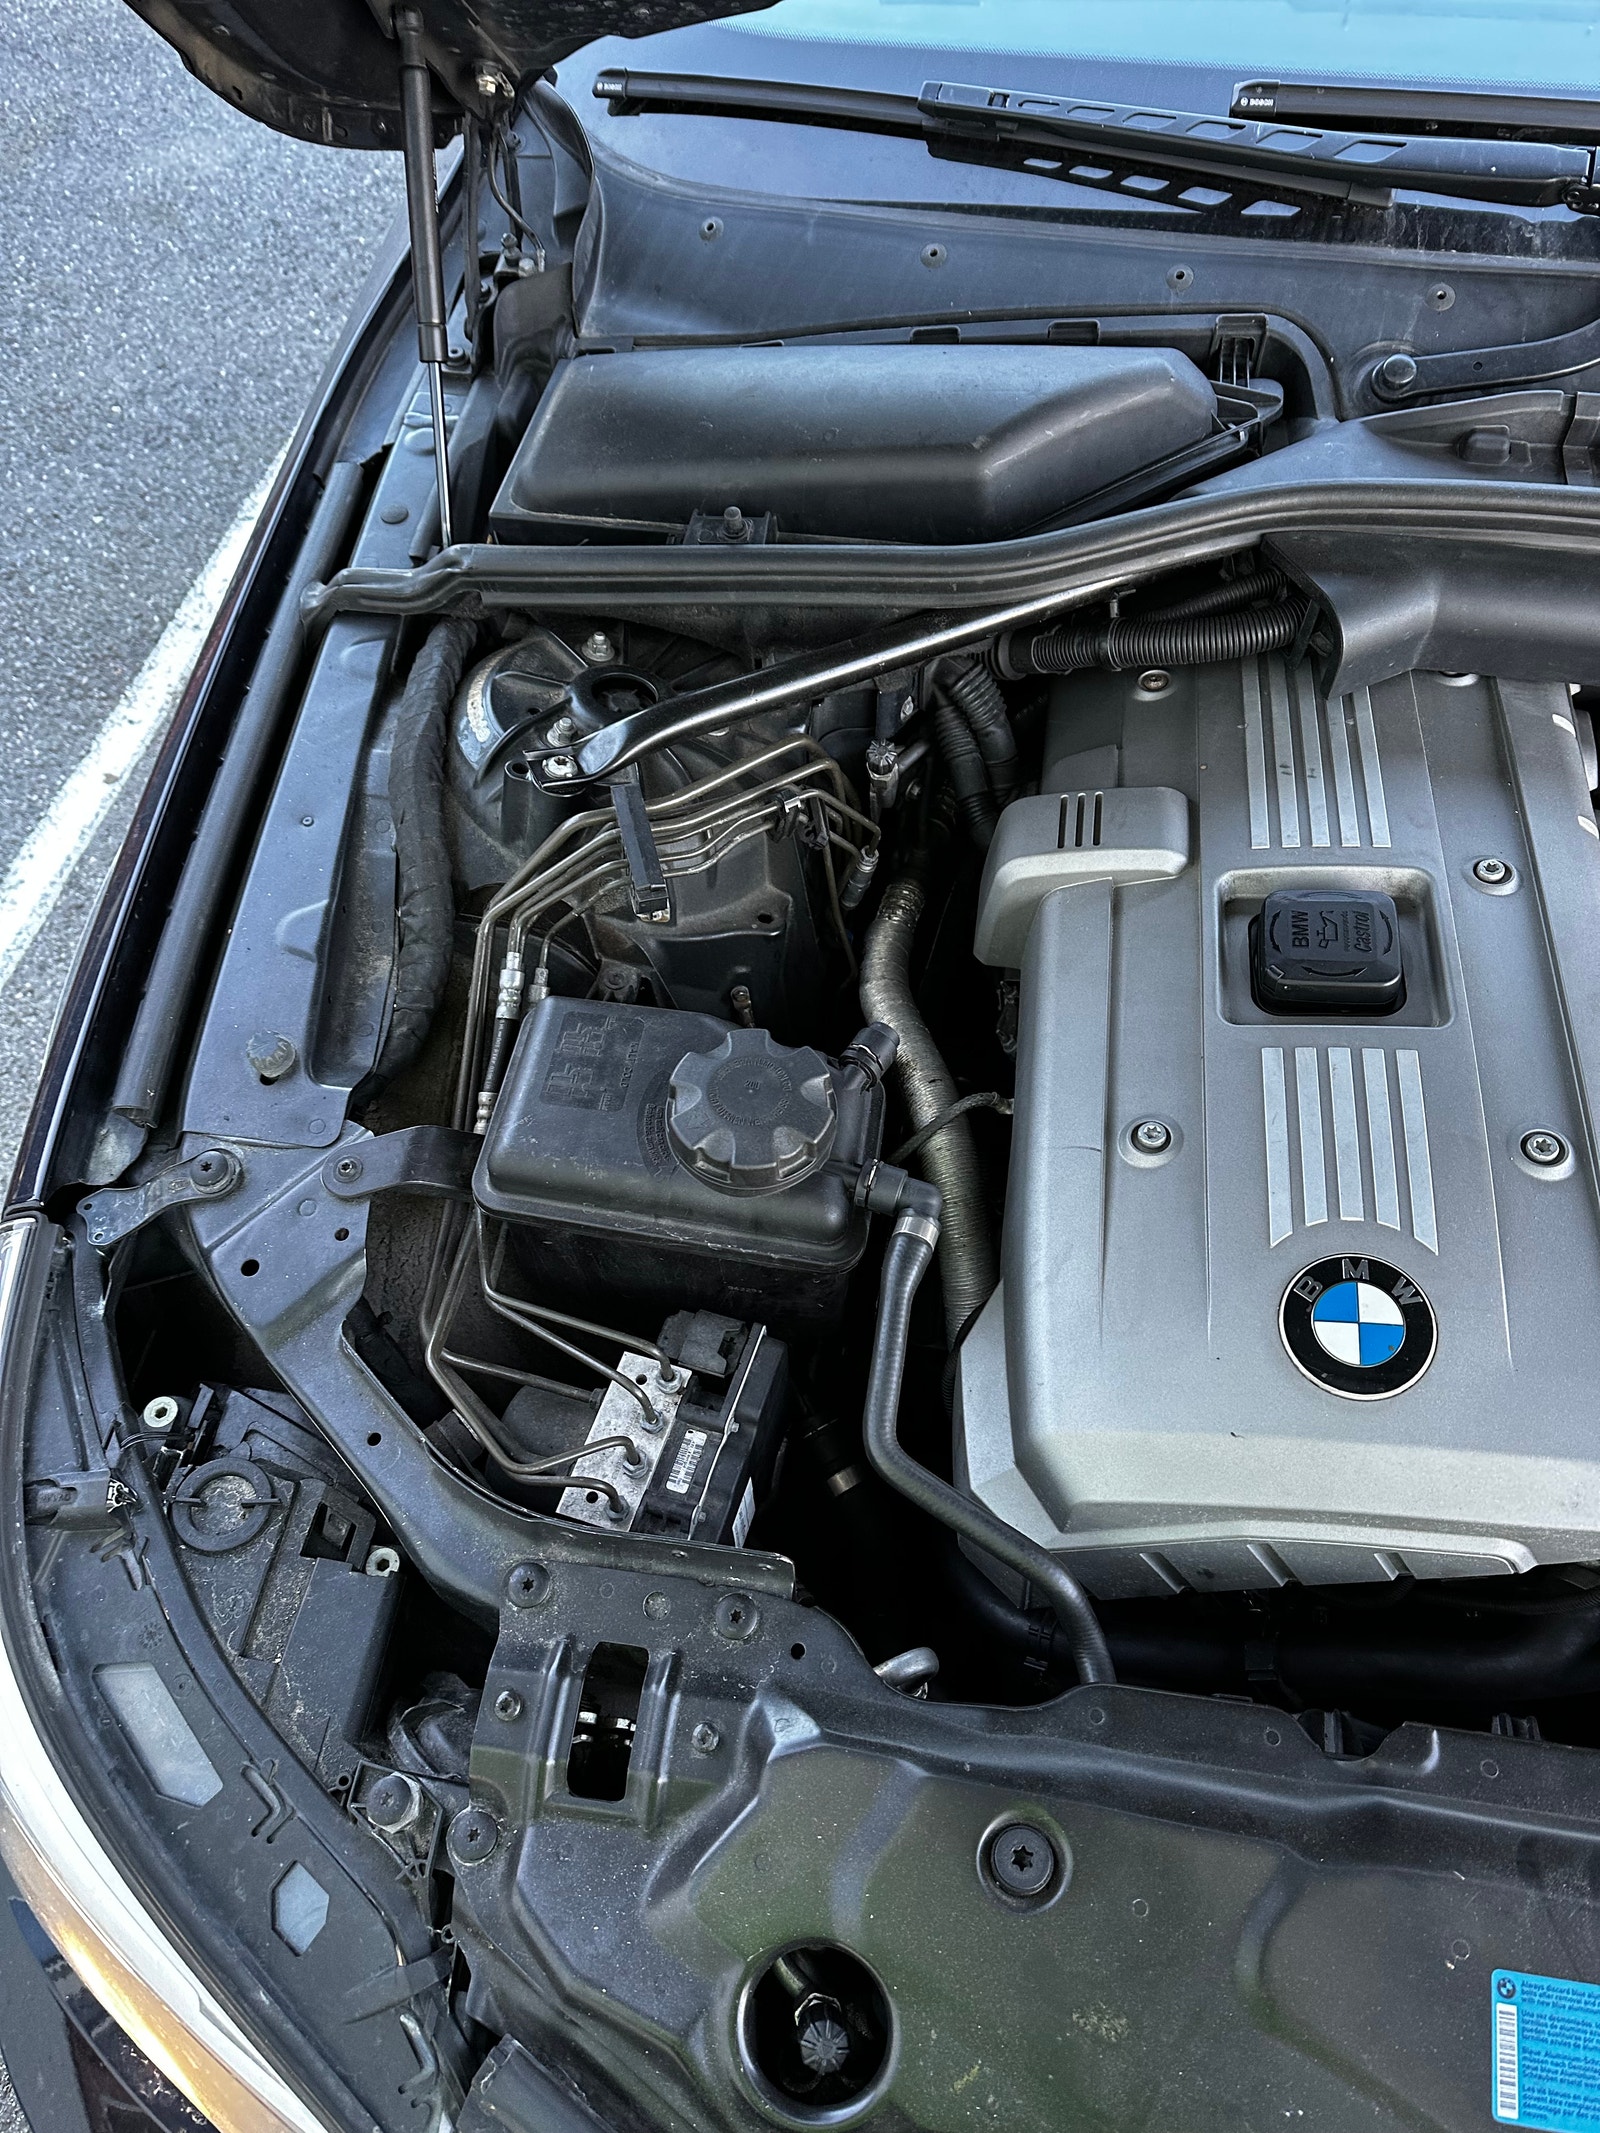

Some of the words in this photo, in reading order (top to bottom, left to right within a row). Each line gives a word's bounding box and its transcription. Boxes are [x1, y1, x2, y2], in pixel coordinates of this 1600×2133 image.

[1291, 910, 1310, 948] BMW
[1352, 910, 1373, 953] Castrol
[1293, 1258, 1424, 1306] BMW
[1521, 1980, 1545, 1991] Always
[1546, 1984, 1570, 1995] discard
[1571, 1988, 1586, 1997] blue
